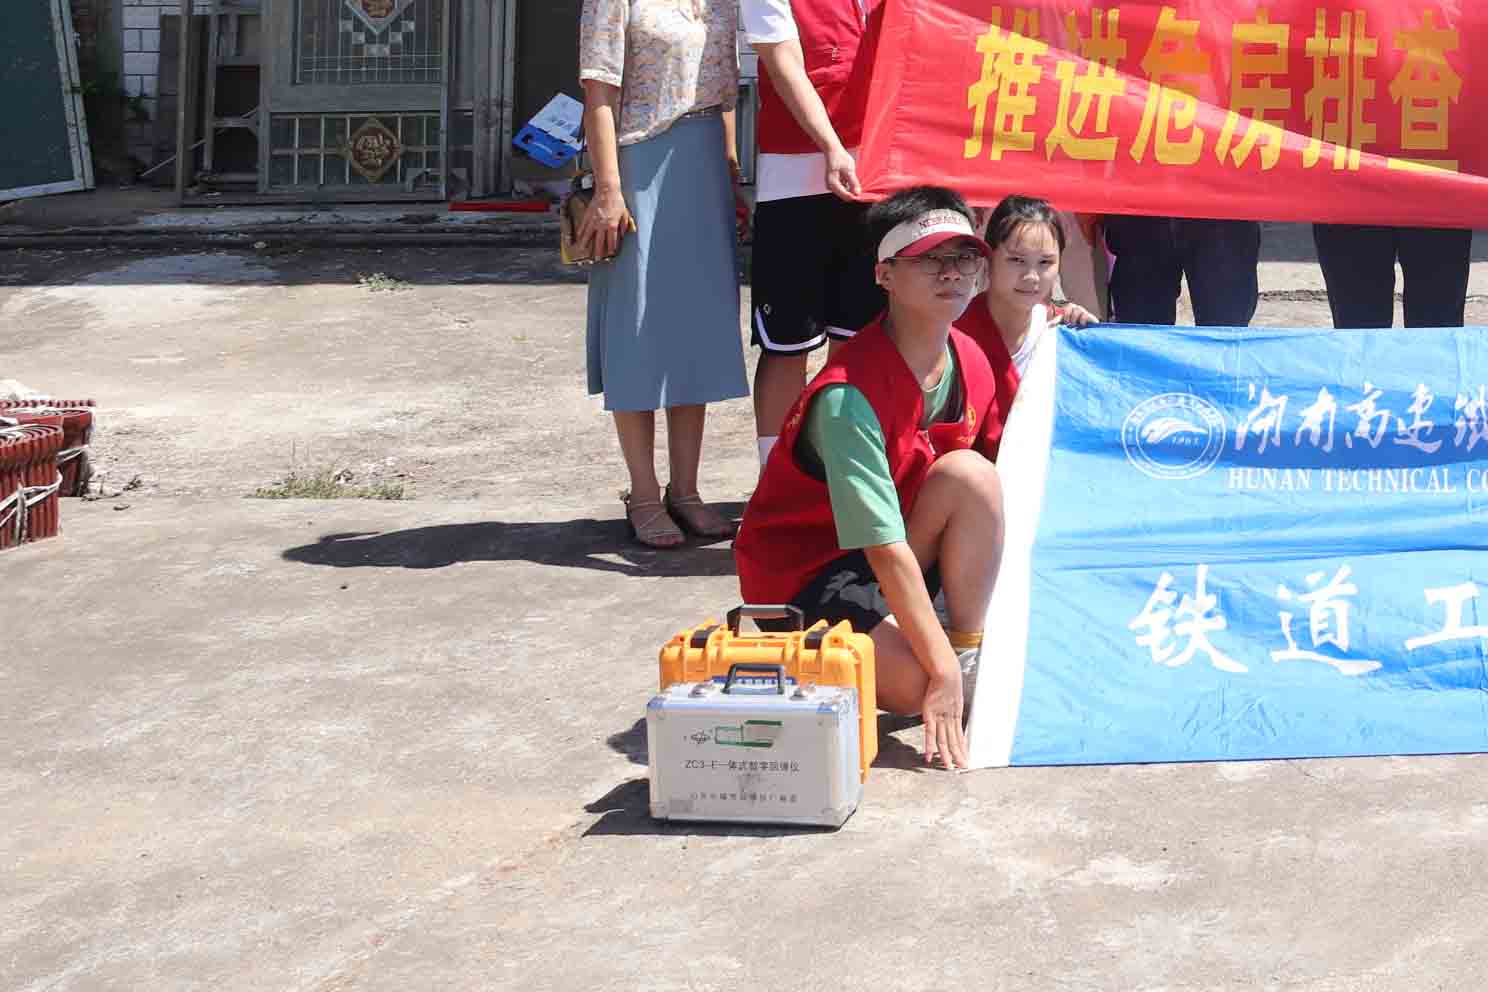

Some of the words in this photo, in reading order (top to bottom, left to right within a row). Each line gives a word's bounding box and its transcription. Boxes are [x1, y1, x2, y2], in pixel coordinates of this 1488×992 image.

[962, 5, 1462, 173] 推进危房排查
[1227, 466, 1312, 489] HUNAN
[1320, 467, 1457, 493] TECHNICAL
